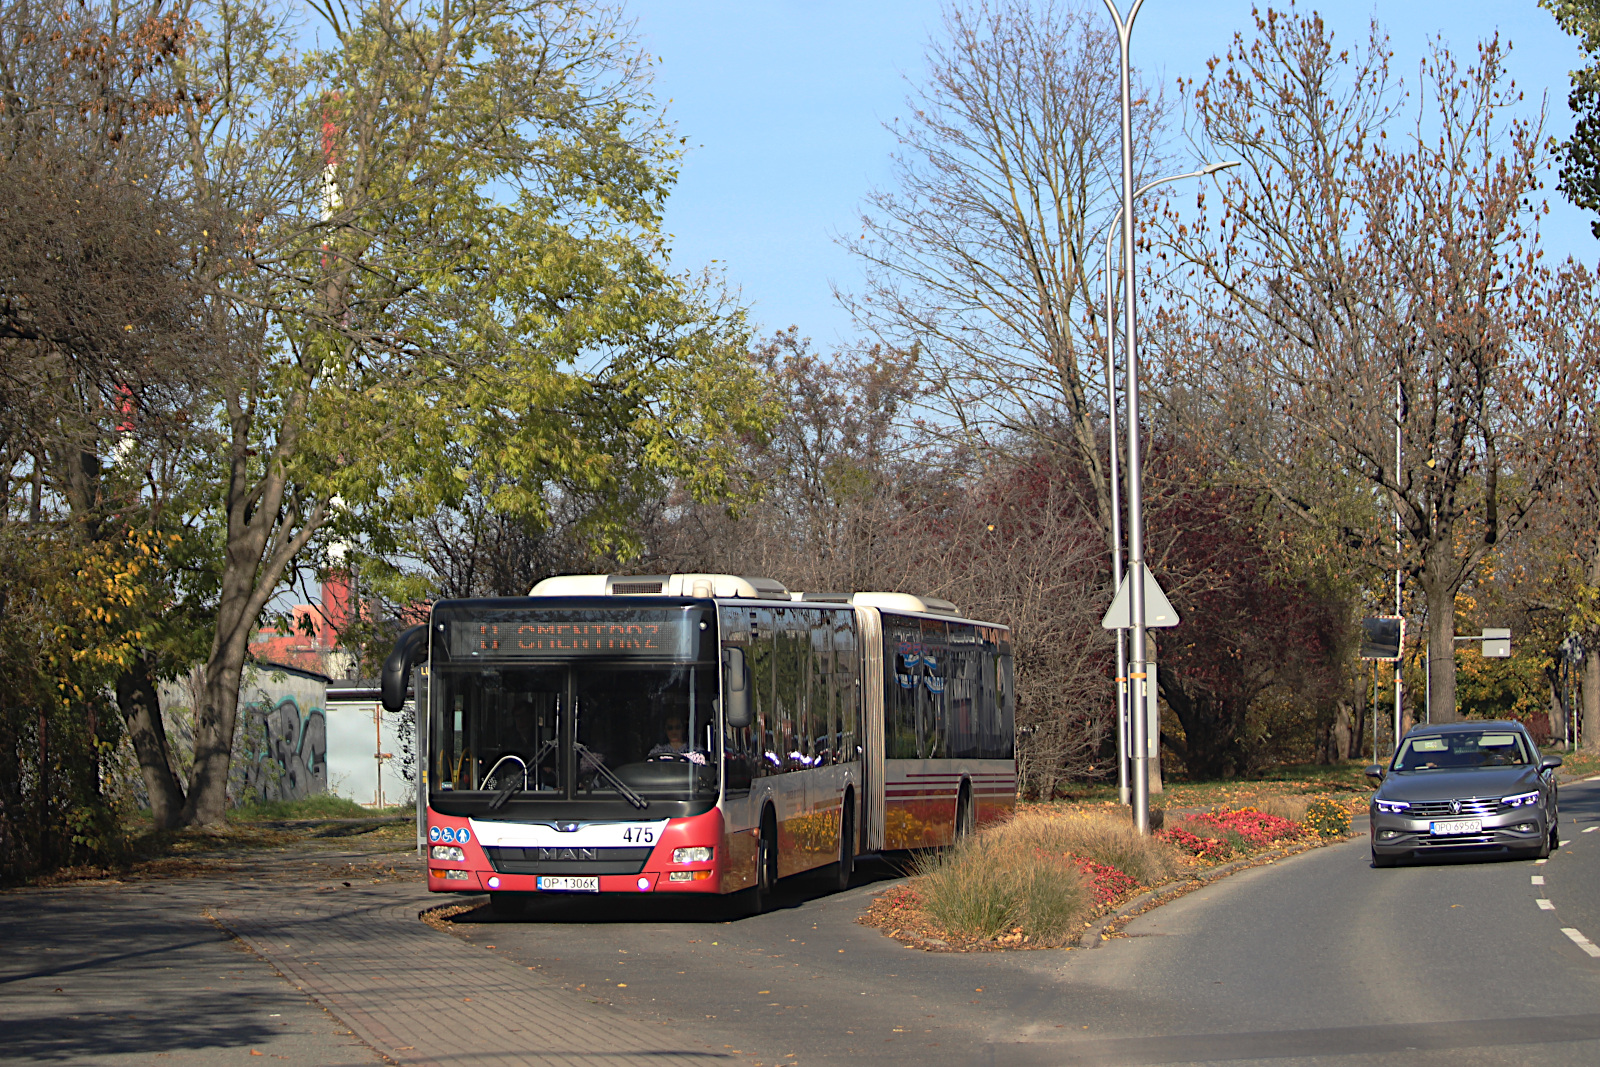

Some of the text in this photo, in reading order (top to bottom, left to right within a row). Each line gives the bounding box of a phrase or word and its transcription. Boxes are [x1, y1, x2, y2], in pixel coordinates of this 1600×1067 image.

[518, 625, 659, 649] CMENTARZ
[623, 827, 653, 843] 475
[539, 848, 598, 860] MAN
[543, 878, 596, 888] OP 1306K
